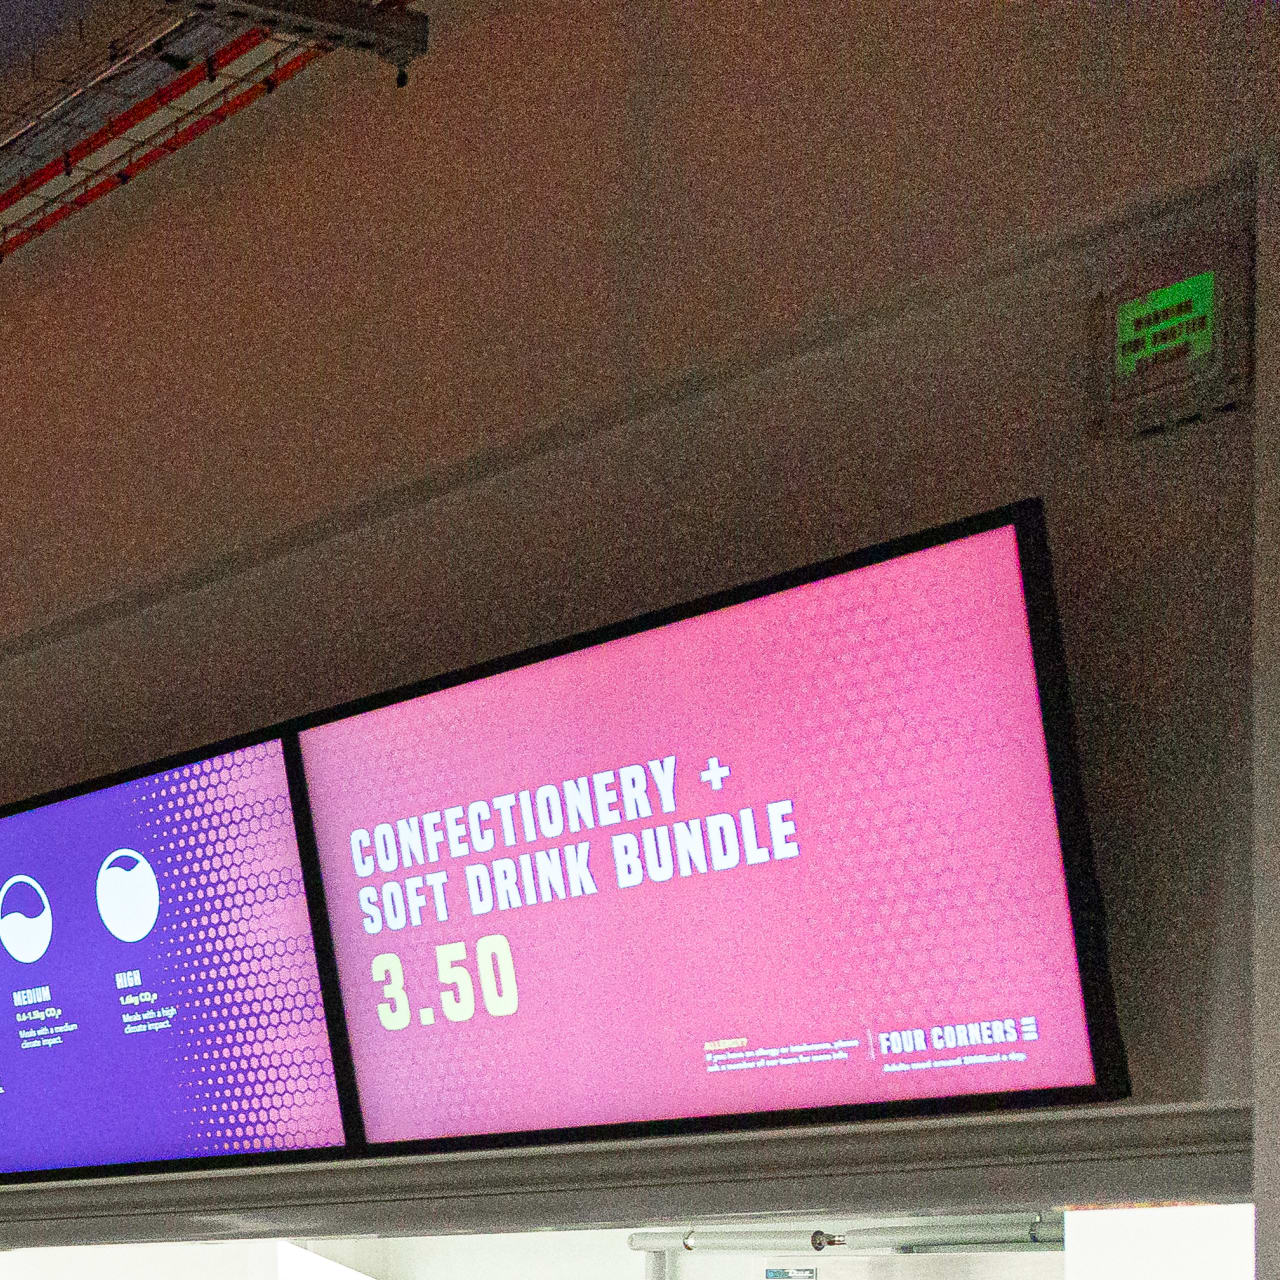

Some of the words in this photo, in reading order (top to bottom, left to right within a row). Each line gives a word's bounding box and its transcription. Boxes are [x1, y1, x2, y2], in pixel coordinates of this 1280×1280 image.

[349, 755, 677, 879] CONFECTIONERY
[699, 756, 731, 791] +
[357, 870, 449, 935] SOFT
[466, 841, 599, 916] DRINK
[610, 798, 800, 889] BUNDLE
[12, 985, 51, 1007] MEDIUM
[115, 969, 142, 989] HIGH
[370, 933, 520, 1031] 3.50
[878, 1028, 927, 1054] FOUR
[931, 1018, 1018, 1050] CORNERS
